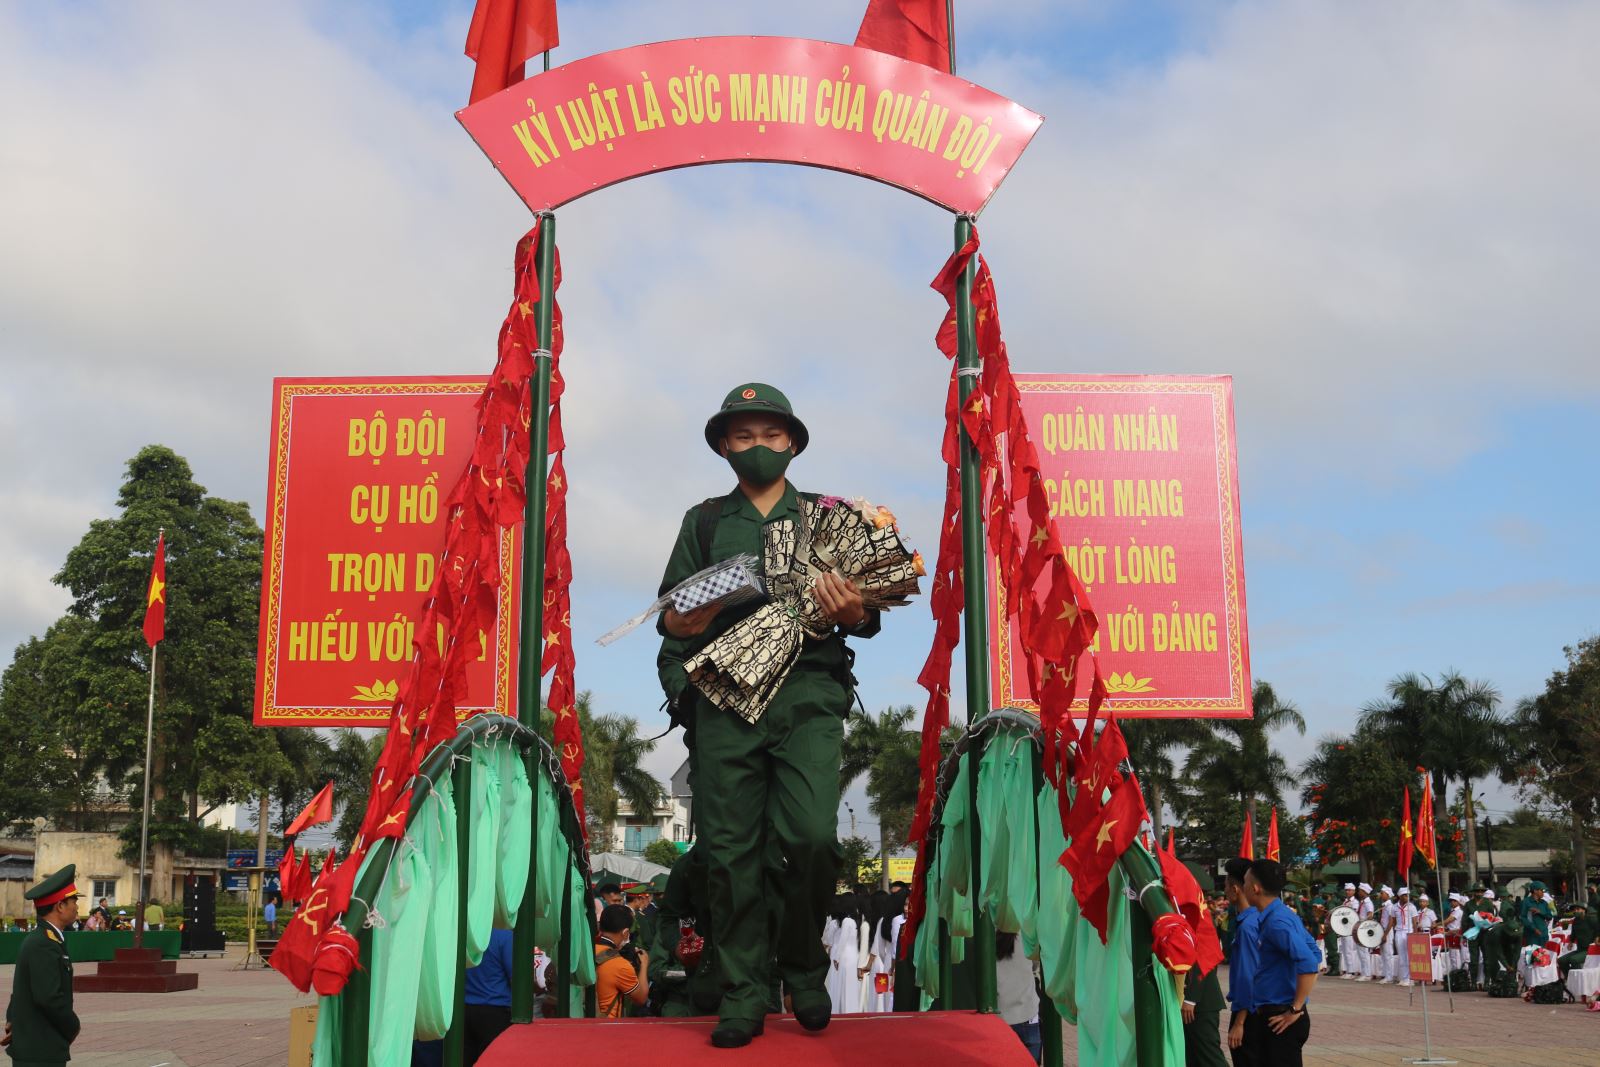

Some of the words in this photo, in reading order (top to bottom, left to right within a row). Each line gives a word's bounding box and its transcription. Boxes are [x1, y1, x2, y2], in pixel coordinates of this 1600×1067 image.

[512, 98, 561, 167] KỶ
[556, 83, 625, 151] LUẬT
[627, 73, 665, 132] LÀ
[669, 65, 722, 125] SỨC
[730, 73, 807, 133] MẠNH
[816, 65, 866, 132] CỦA
[871, 89, 948, 153] QUÂN
[943, 117, 1002, 179] ĐỘI
[348, 409, 388, 466] BỘ
[395, 409, 446, 465] ĐỘI
[1042, 406, 1105, 454] QUÂN
[1113, 406, 1178, 452] NHÂN
[350, 485, 390, 533] CỤ
[398, 471, 439, 525] HỒ
[1043, 471, 1105, 517] CÁCH
[1114, 479, 1184, 526] MẠNG
[327, 553, 406, 602] TRỌN
[416, 553, 435, 592] D
[1115, 537, 1177, 584] LÒNG
[288, 609, 358, 662] HIẾU
[368, 612, 415, 662] VỚI
[1107, 604, 1145, 652] VỚI
[1152, 601, 1218, 652] ĐẢNG
